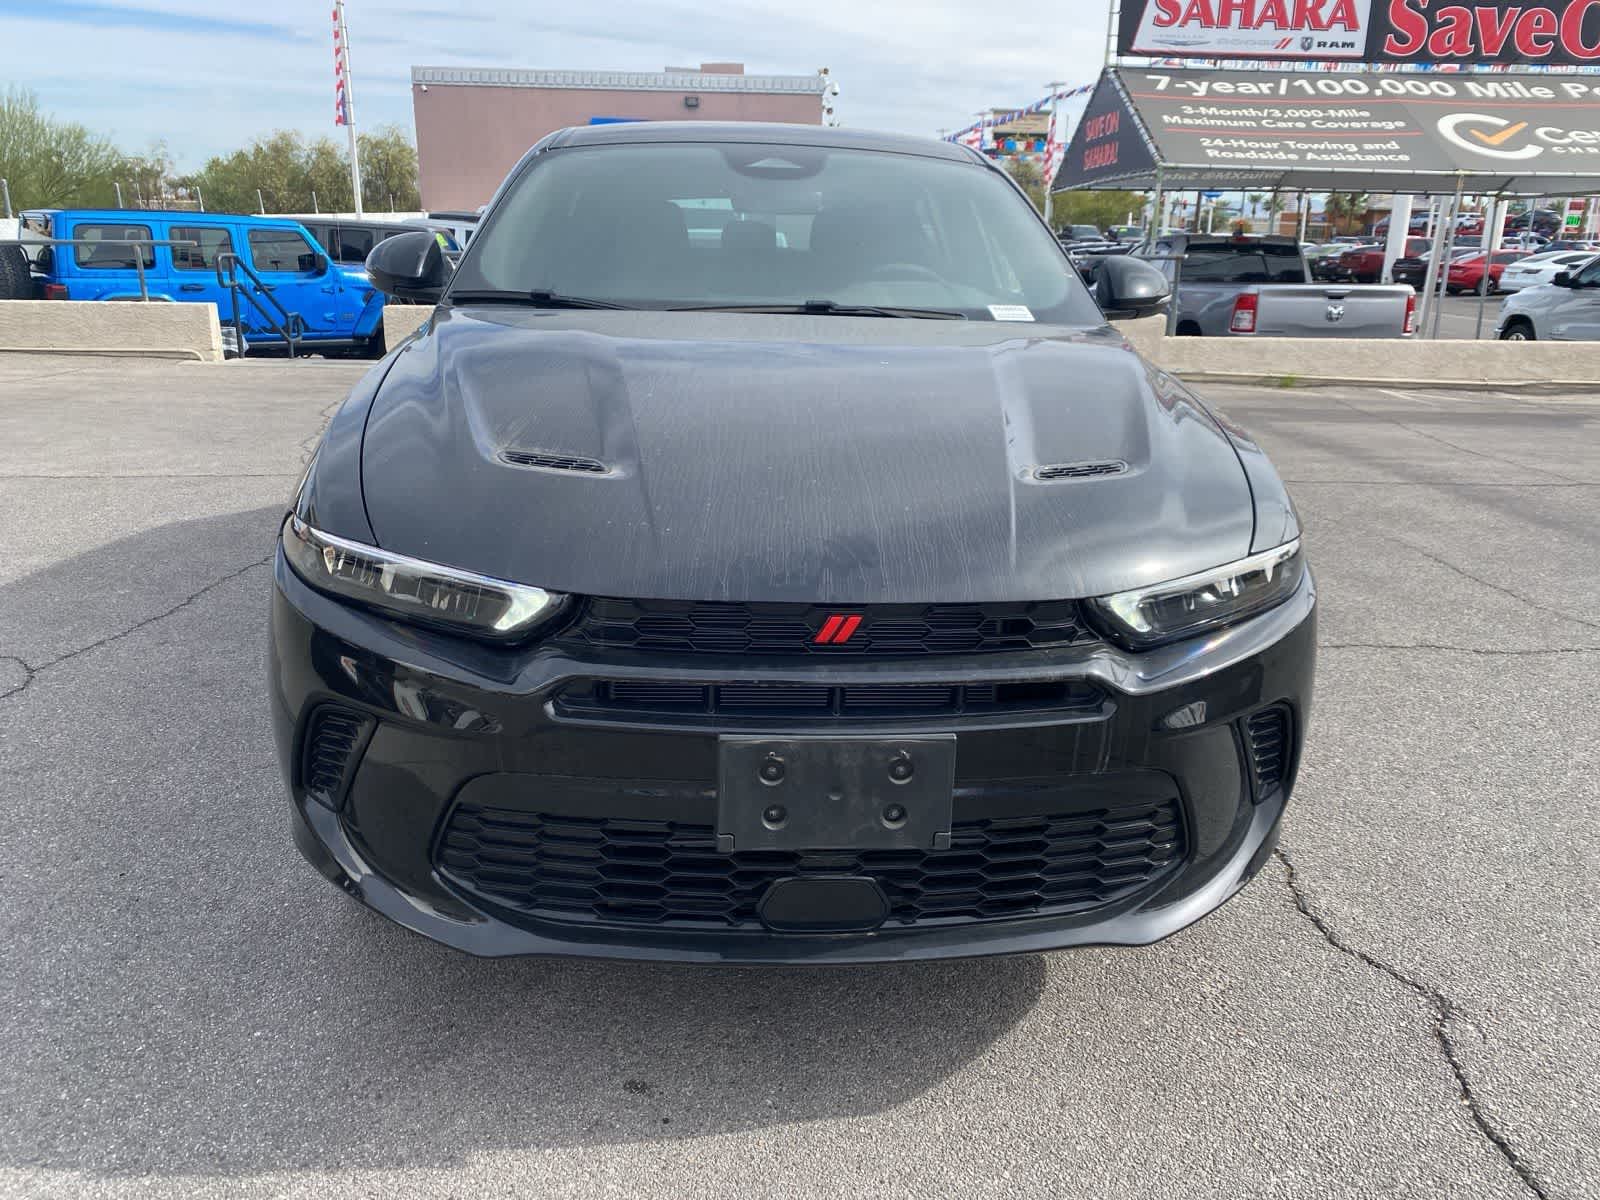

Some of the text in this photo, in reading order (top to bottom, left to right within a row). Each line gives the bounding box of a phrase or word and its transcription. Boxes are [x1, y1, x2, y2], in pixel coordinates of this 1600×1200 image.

[1152, 0, 1361, 31] SAHARA
[1316, 40, 1356, 49] RAM
[1464, 81, 1556, 99] Mile
[1560, 82, 1600, 98] P
[1105, 110, 1120, 134] ON
[1162, 115, 1406, 130] Maximum Care Coverage
[1199, 137, 1400, 152] 24-Hour Towing and
[1205, 148, 1411, 161] Roadside Assistance
